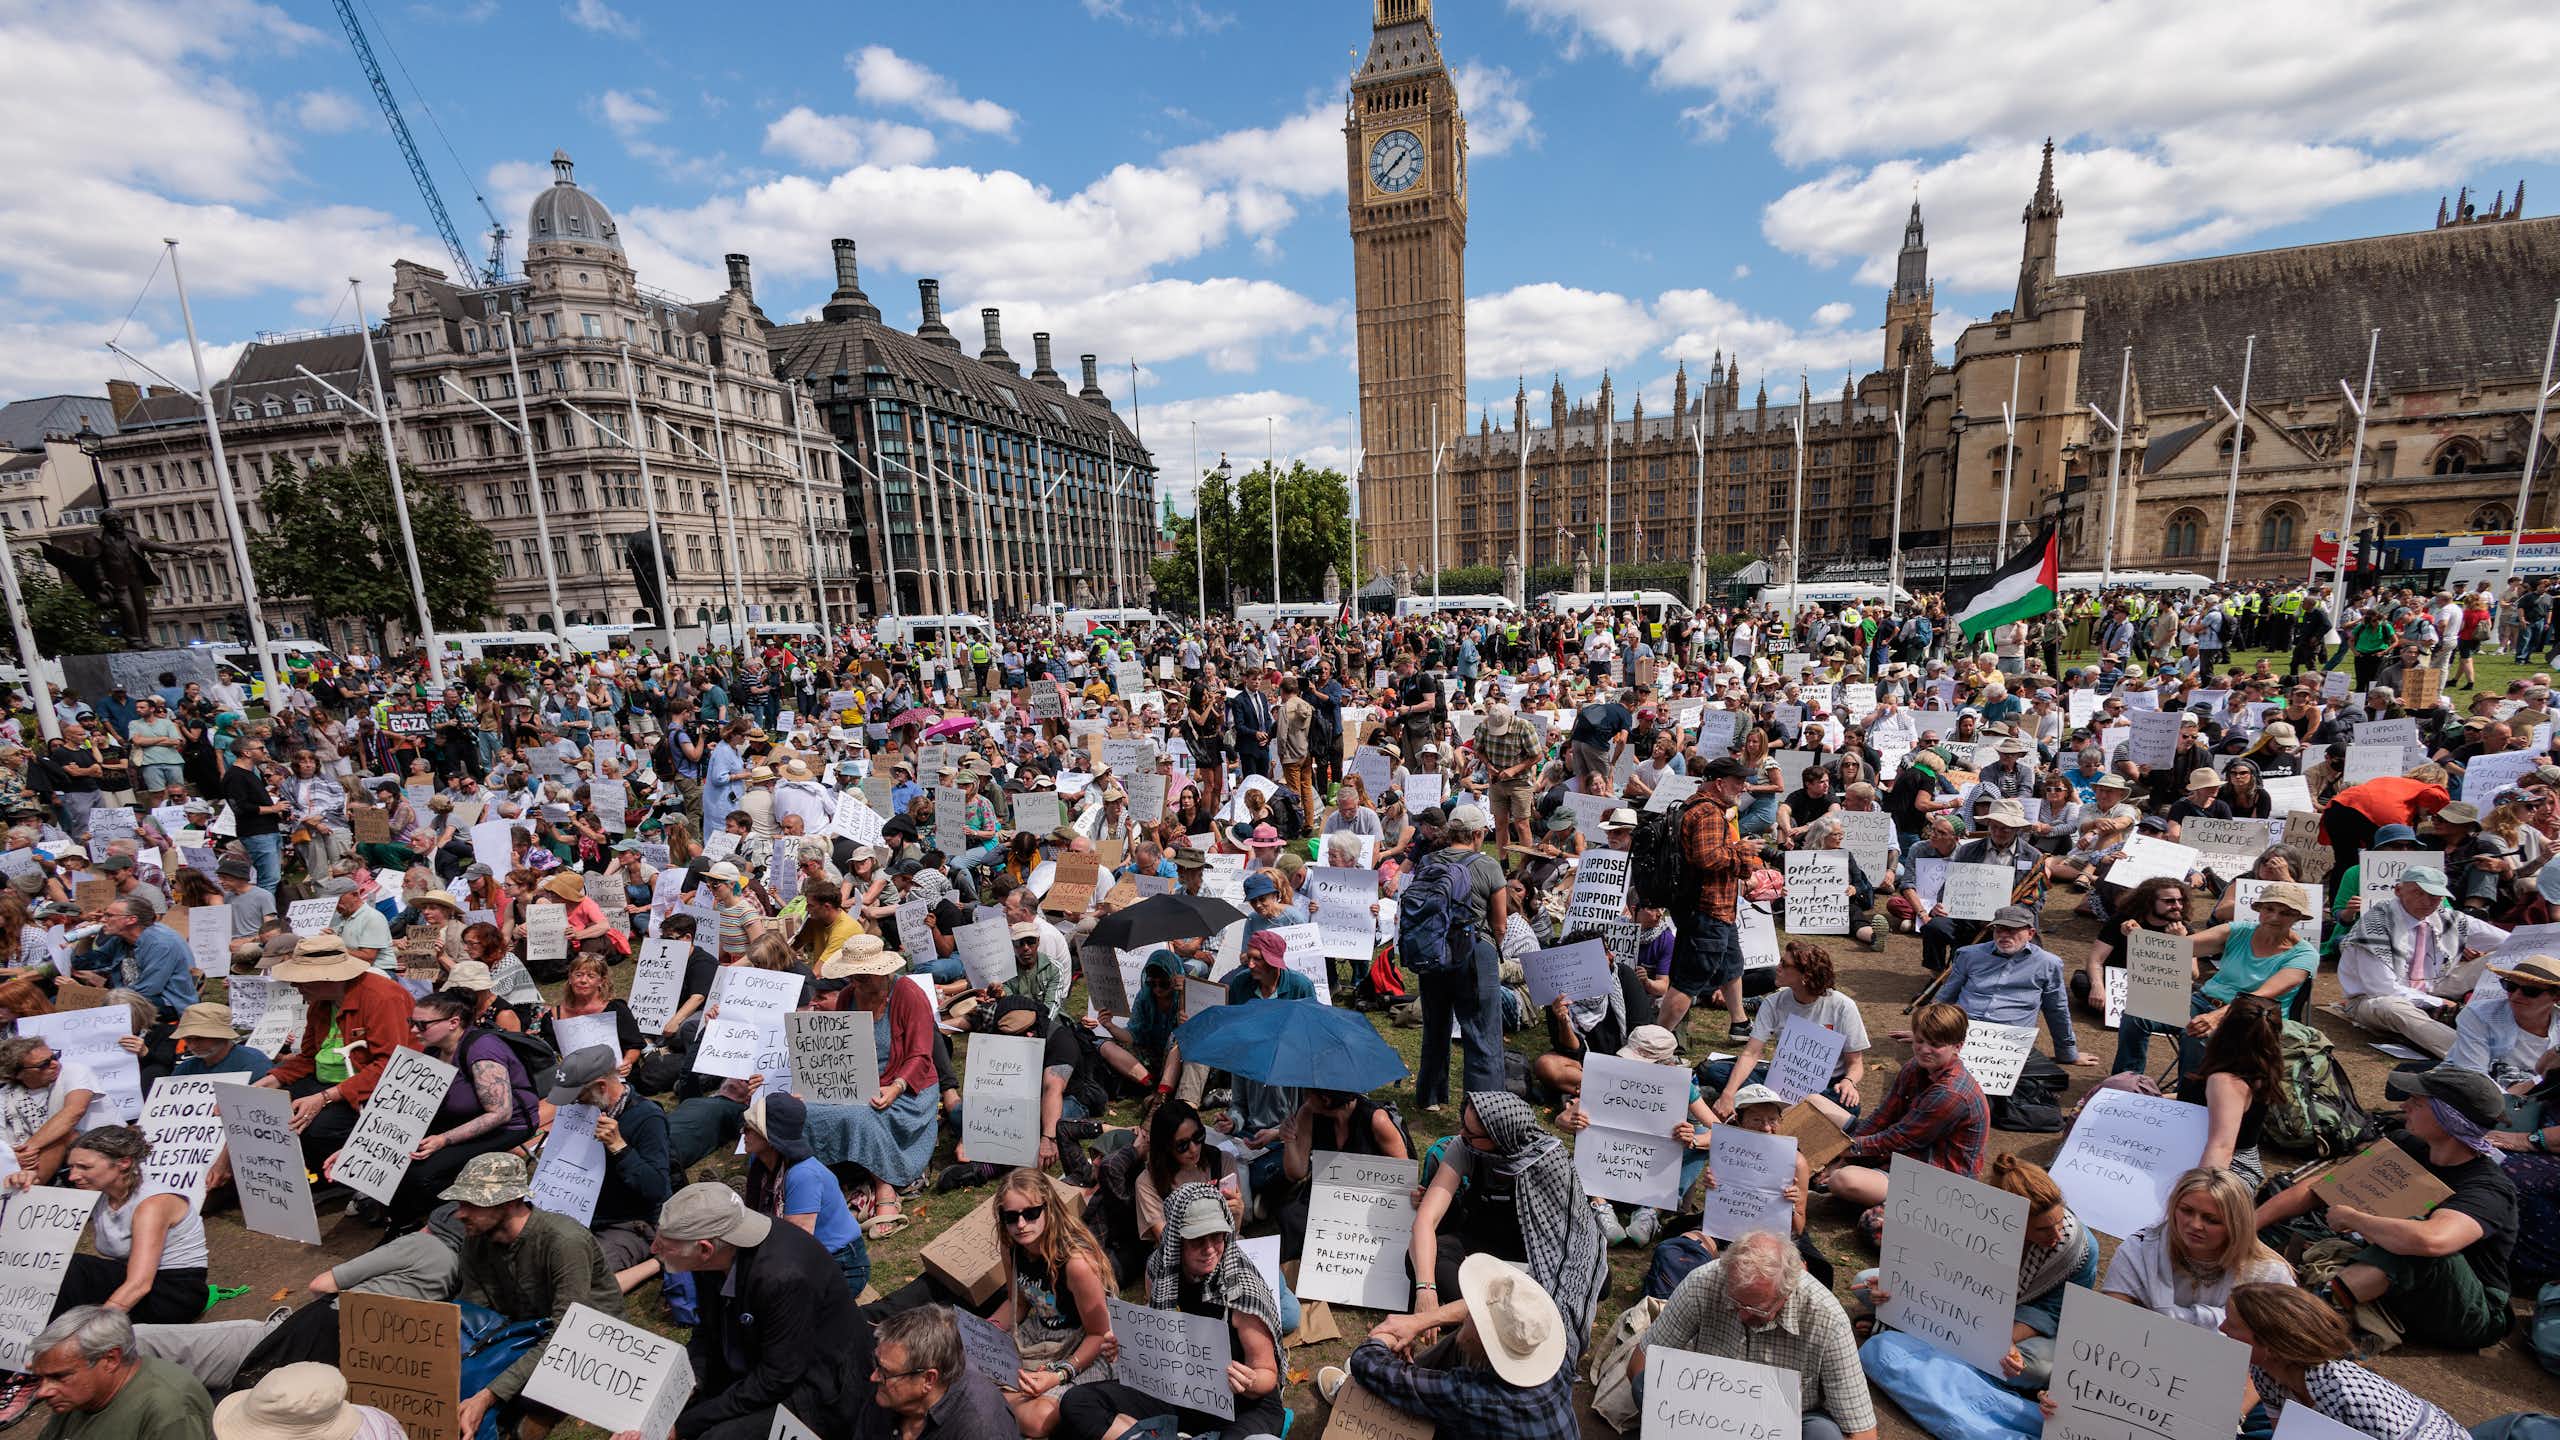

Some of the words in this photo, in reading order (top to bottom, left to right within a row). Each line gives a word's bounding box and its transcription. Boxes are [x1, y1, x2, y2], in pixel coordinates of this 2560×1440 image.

[2471, 548, 2505, 556] MORE
[2516, 546, 2543, 555] HAN
[471, 636, 514, 644] POLICE
[1768, 643, 1789, 652] GAZA
[390, 719, 430, 732] GAZA
[2372, 724, 2404, 735] OPPOSE
[2360, 735, 2409, 745] GENOCIDE
[2203, 820, 2247, 833] OPPOSE
[1846, 831, 1889, 843] ENOCIDE
[2198, 831, 2255, 847] GENOCIDE
[1586, 857, 1625, 874] OPPOSE
[1788, 865, 1837, 877] OPPOSE
[1577, 871, 1626, 888] GENOCIDE
[1575, 891, 1622, 907] SUPPORT
[1787, 894, 1840, 905] SUPPORT
[298, 902, 338, 915] OPPOSE
[1568, 906, 1619, 921] PALESTINE
[1788, 904, 1849, 915] PALESTINE
[291, 918, 332, 931] ENOCIDE
[1799, 915, 1850, 928] ACTION
[2145, 936, 2177, 949] OPPOSE
[659, 946, 669, 959] I
[2132, 948, 2177, 961] GENOCIDE
[639, 959, 673, 970] OPPOSE
[2140, 963, 2182, 977] SUPPORT
[728, 972, 736, 986] I
[745, 975, 791, 991] OPPOSE
[2131, 975, 2181, 990] PALESTINE
[724, 994, 778, 1009] GENOCIDE
[796, 1018, 804, 1033] I
[810, 1015, 850, 1031] OPPOSE
[795, 1034, 853, 1053] GENOCIDE
[1784, 1029, 1791, 1046] I
[1969, 1028, 2033, 1041] OPPOSE
[796, 1056, 804, 1069] I
[810, 1054, 855, 1069] SUPPORT
[386, 1054, 402, 1078] I
[395, 1058, 449, 1100] OPPOSE
[800, 1070, 857, 1088] PALESTINE
[155, 1084, 162, 1098] I
[817, 1087, 858, 1099] ACTION
[1620, 1079, 1665, 1095] OPPOSE
[374, 1083, 435, 1124] GENOCIDE
[1602, 1093, 1668, 1112] GENOCIDE
[2102, 1091, 2122, 1101] I
[2131, 1098, 2194, 1118] OPPOSE
[249, 1108, 281, 1126] OPPOSE
[2092, 1103, 2168, 1128] GENOCIDE
[152, 1126, 224, 1144] SUPPORT
[228, 1123, 291, 1146] GENOCIDE
[358, 1112, 371, 1133] I
[368, 1116, 413, 1144] SUPPORT
[1612, 1141, 1657, 1158] SUPPORT
[2081, 1127, 2097, 1138] I
[2106, 1134, 2166, 1157] SUPPORT
[351, 1136, 408, 1170] PALESTINE
[1596, 1151, 1652, 1170] PALESTINE
[1728, 1146, 1764, 1160] OPPOSE
[2077, 1141, 2158, 1171] PALESTINE
[246, 1155, 285, 1172] SUPPORT
[338, 1155, 388, 1188] ACTION
[2065, 1158, 2134, 1185] ACTION
[241, 1168, 295, 1193] PALESTINE
[1329, 1165, 1342, 1180] I
[1356, 1169, 1405, 1184] OPPOSE
[1605, 1167, 1643, 1182] ACTION
[245, 1182, 289, 1211] ACTION
[533, 1182, 591, 1213] PALESTINE
[1333, 1191, 1398, 1209] GENOCIDE
[1904, 1169, 1921, 1197] I
[1936, 1185, 2021, 1232] OPPOSE
[18, 1204, 89, 1231] OPPOSE
[1315, 1229, 1327, 1240] I
[1336, 1232, 1391, 1247] SUPPORT
[1895, 1199, 2004, 1262] GENOCIDE
[1317, 1248, 1376, 1264] PALESTINE
[1315, 1262, 1363, 1275] ACTION
[1888, 1244, 1910, 1265] I
[1929, 1261, 2011, 1305] SUPPORT
[1890, 1271, 1985, 1330] PALESTINE
[350, 1303, 355, 1344] I
[362, 1307, 447, 1348] OPPOSE
[1109, 1304, 1120, 1320] I
[1127, 1311, 1187, 1333] OPPOSE
[1901, 1307, 1962, 1346] ACTION
[568, 1311, 577, 1329] I
[588, 1322, 667, 1364] OPPOSE
[346, 1348, 433, 1379] GENOCIDE
[1118, 1344, 1130, 1360] I
[1138, 1353, 1218, 1381] SUPPORT
[2072, 1339, 2188, 1401] OPPOSE
[542, 1343, 649, 1402] GENOCIDE
[1656, 1359, 1665, 1389] I
[1677, 1367, 1763, 1399] OPPOSE
[368, 1390, 447, 1418] SUPPORT
[2067, 1369, 2176, 1433] GENOCIDE
[1657, 1400, 1783, 1440] GENOCIDE
